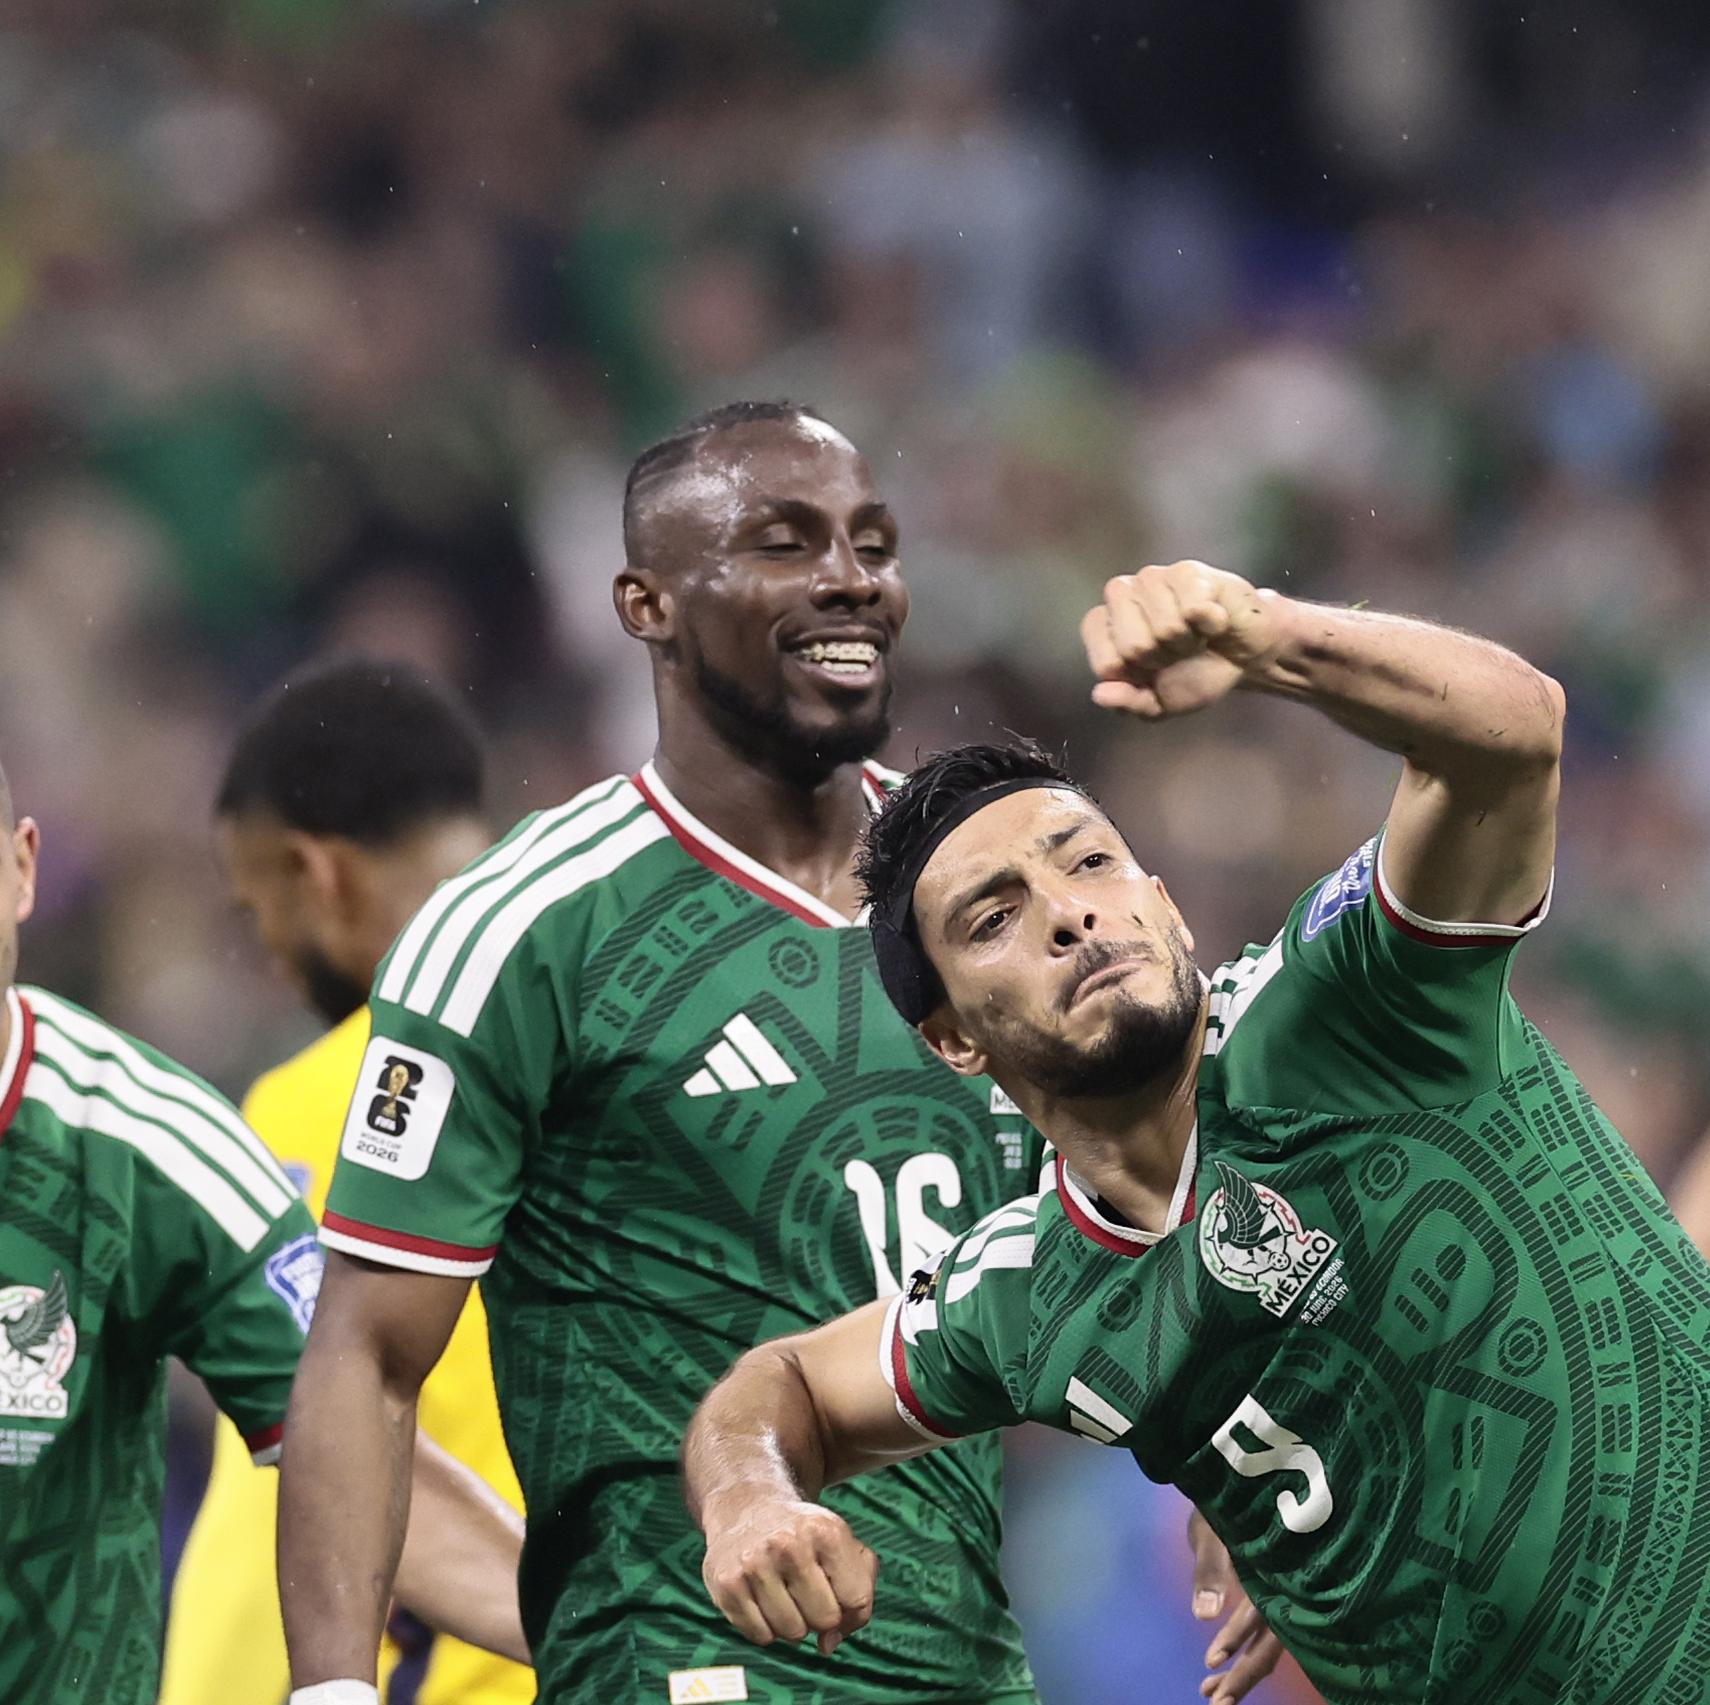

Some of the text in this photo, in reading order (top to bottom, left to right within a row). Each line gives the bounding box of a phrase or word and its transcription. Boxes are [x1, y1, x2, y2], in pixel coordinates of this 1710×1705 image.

[356, 1140, 399, 1162] 2026
[1265, 1236, 1330, 1314] MÉXICO
[1324, 1275, 1343, 1296] 2026
[1333, 1283, 1350, 1301] CITY
[1211, 1394, 1334, 1533] 9
